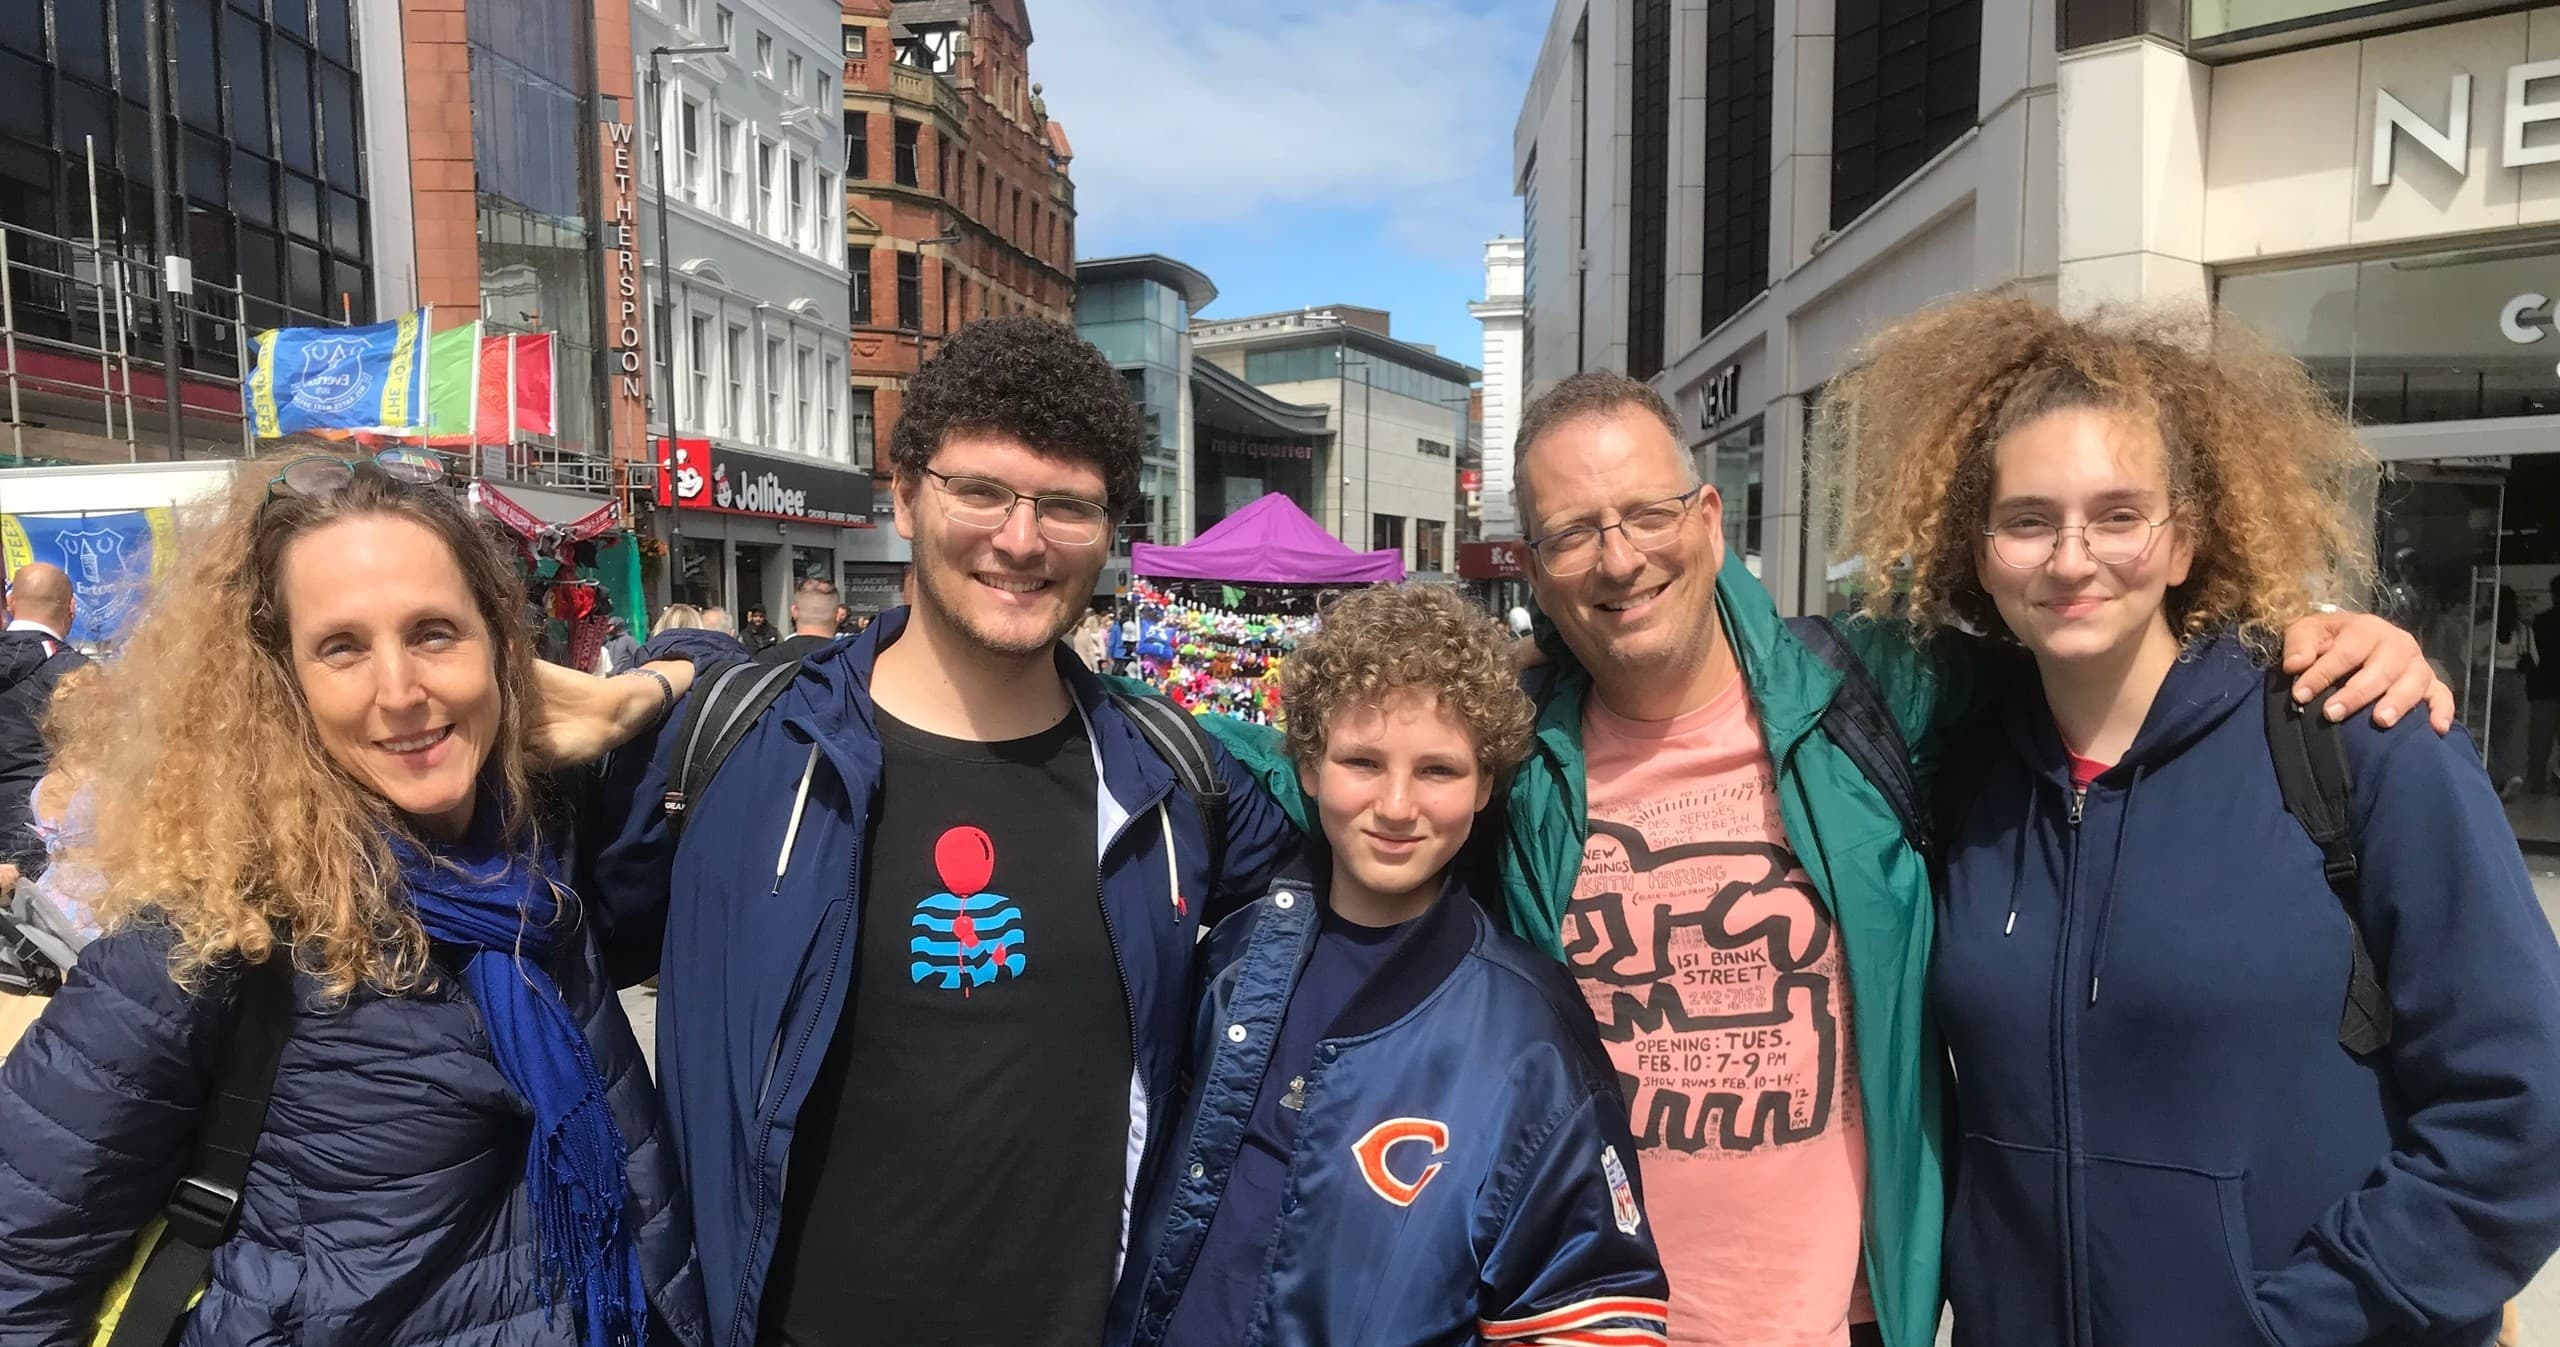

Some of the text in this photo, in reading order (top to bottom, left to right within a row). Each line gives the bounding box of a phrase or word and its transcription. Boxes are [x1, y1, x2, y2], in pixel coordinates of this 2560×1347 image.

[2372, 58, 2560, 186] NE
[608, 120, 641, 397] WETHERSPOON
[2501, 293, 2560, 344] C
[1699, 364, 1741, 431] NEXT
[735, 470, 805, 517] Jollibee
[1647, 818, 1670, 831] DES
[1675, 813, 1750, 835] WESTBETH
[1727, 821, 1780, 838] PRESEN
[1583, 846, 1617, 861] NEW
[1580, 861, 1630, 876] AWINGS
[1648, 864, 1727, 891] HARING
[1677, 947, 1768, 970] 151 BANK
[1683, 964, 1768, 985] STREET
[1635, 1029, 1792, 1054] OPENING: TUES.
[1638, 1054, 1679, 1072] FEB.
[1716, 1051, 1761, 1078] 7-9
[1767, 1052, 1787, 1066] PM
[1643, 1076, 1676, 1088] SHOW
[1682, 1077, 1717, 1089] RUNS
[1722, 1077, 1750, 1090] FEB.
[1795, 1088, 1809, 1098] 12
[1794, 1107, 1803, 1118] 6
